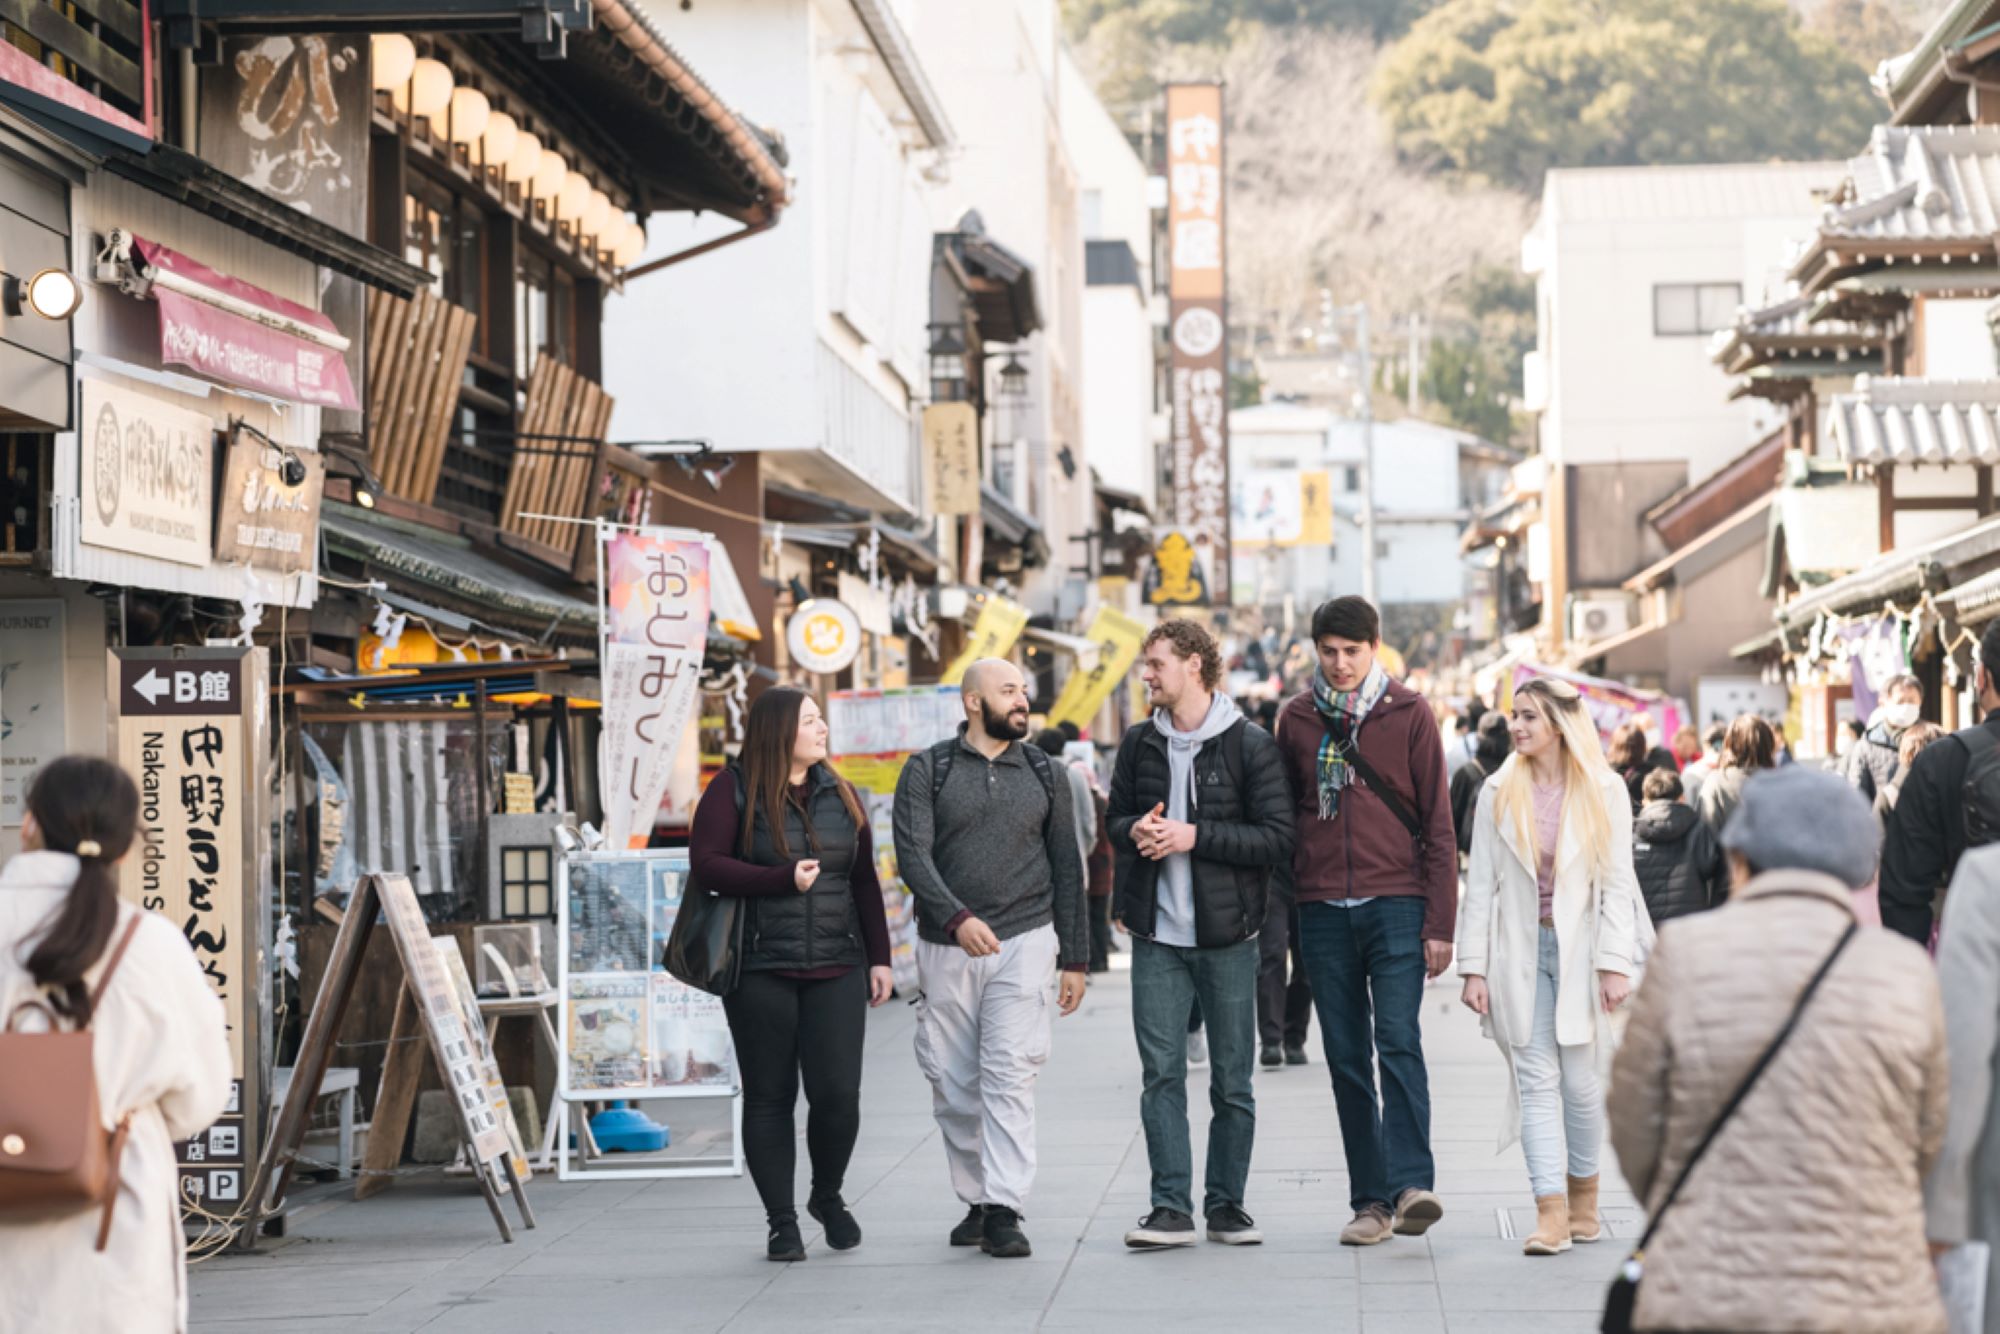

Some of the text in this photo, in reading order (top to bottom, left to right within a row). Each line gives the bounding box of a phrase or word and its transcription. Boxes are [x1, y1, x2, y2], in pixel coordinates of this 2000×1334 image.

[174, 671, 231, 702] B館
[142, 731, 166, 823] Nakano
[142, 828, 166, 891] Udon
[217, 1174, 232, 1197] P
